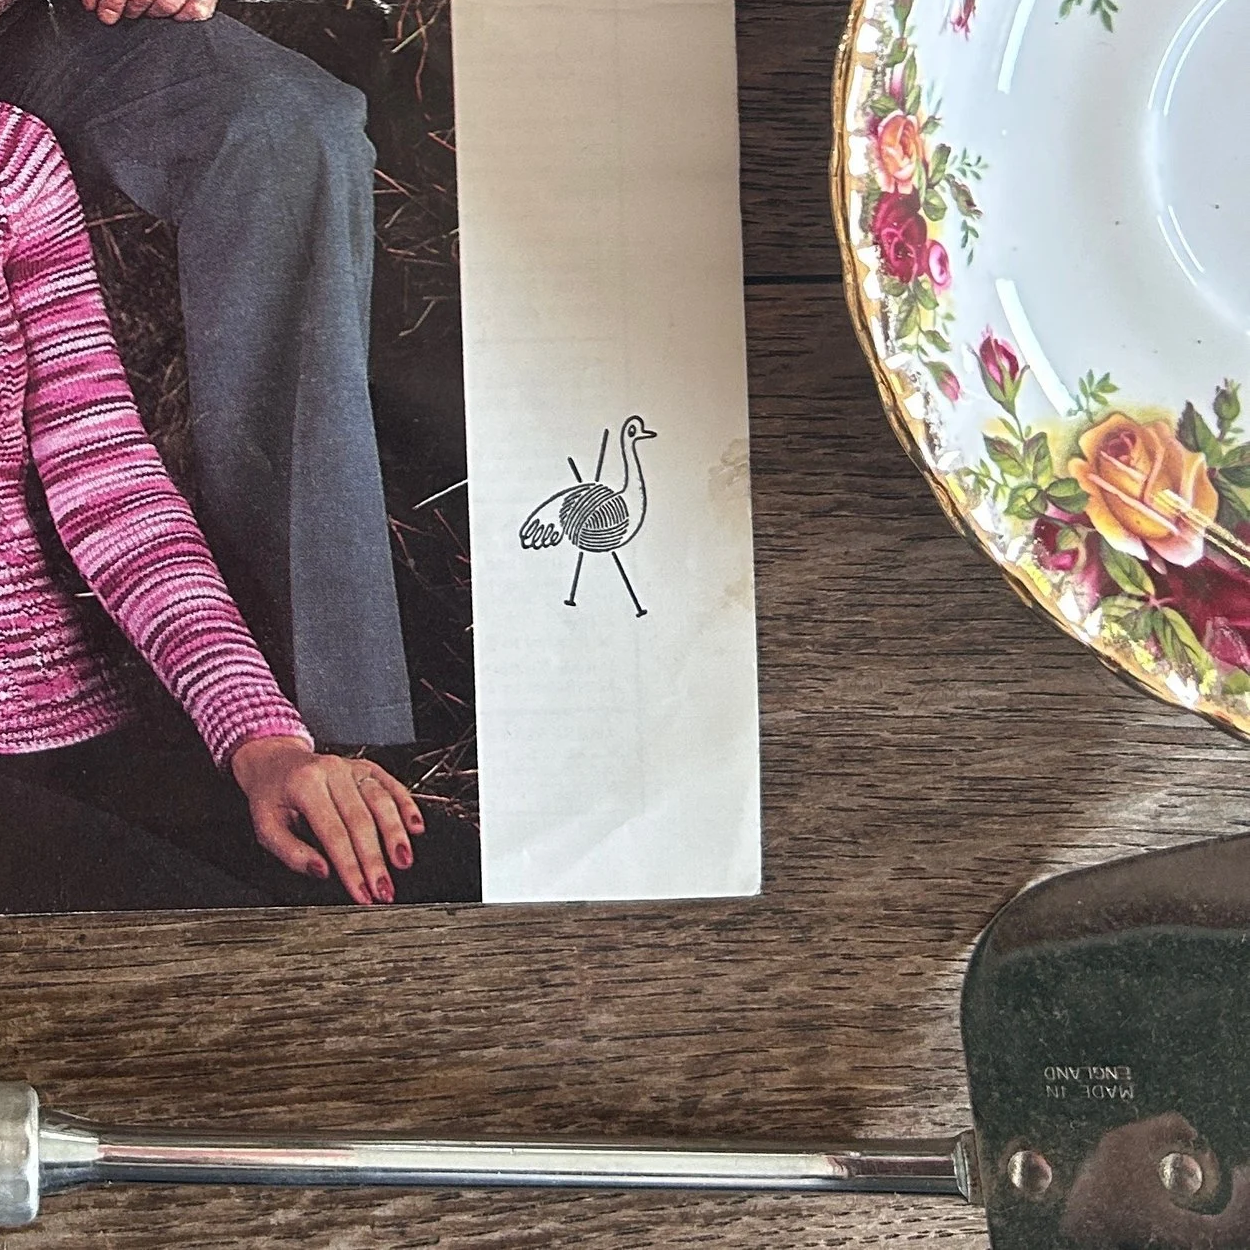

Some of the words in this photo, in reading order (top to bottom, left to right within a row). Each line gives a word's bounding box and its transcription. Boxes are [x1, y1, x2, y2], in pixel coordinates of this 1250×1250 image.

[1044, 1065, 1132, 1081] ENGLAND
[1046, 1084, 1066, 1099] IN
[1079, 1084, 1134, 1099] MADE
